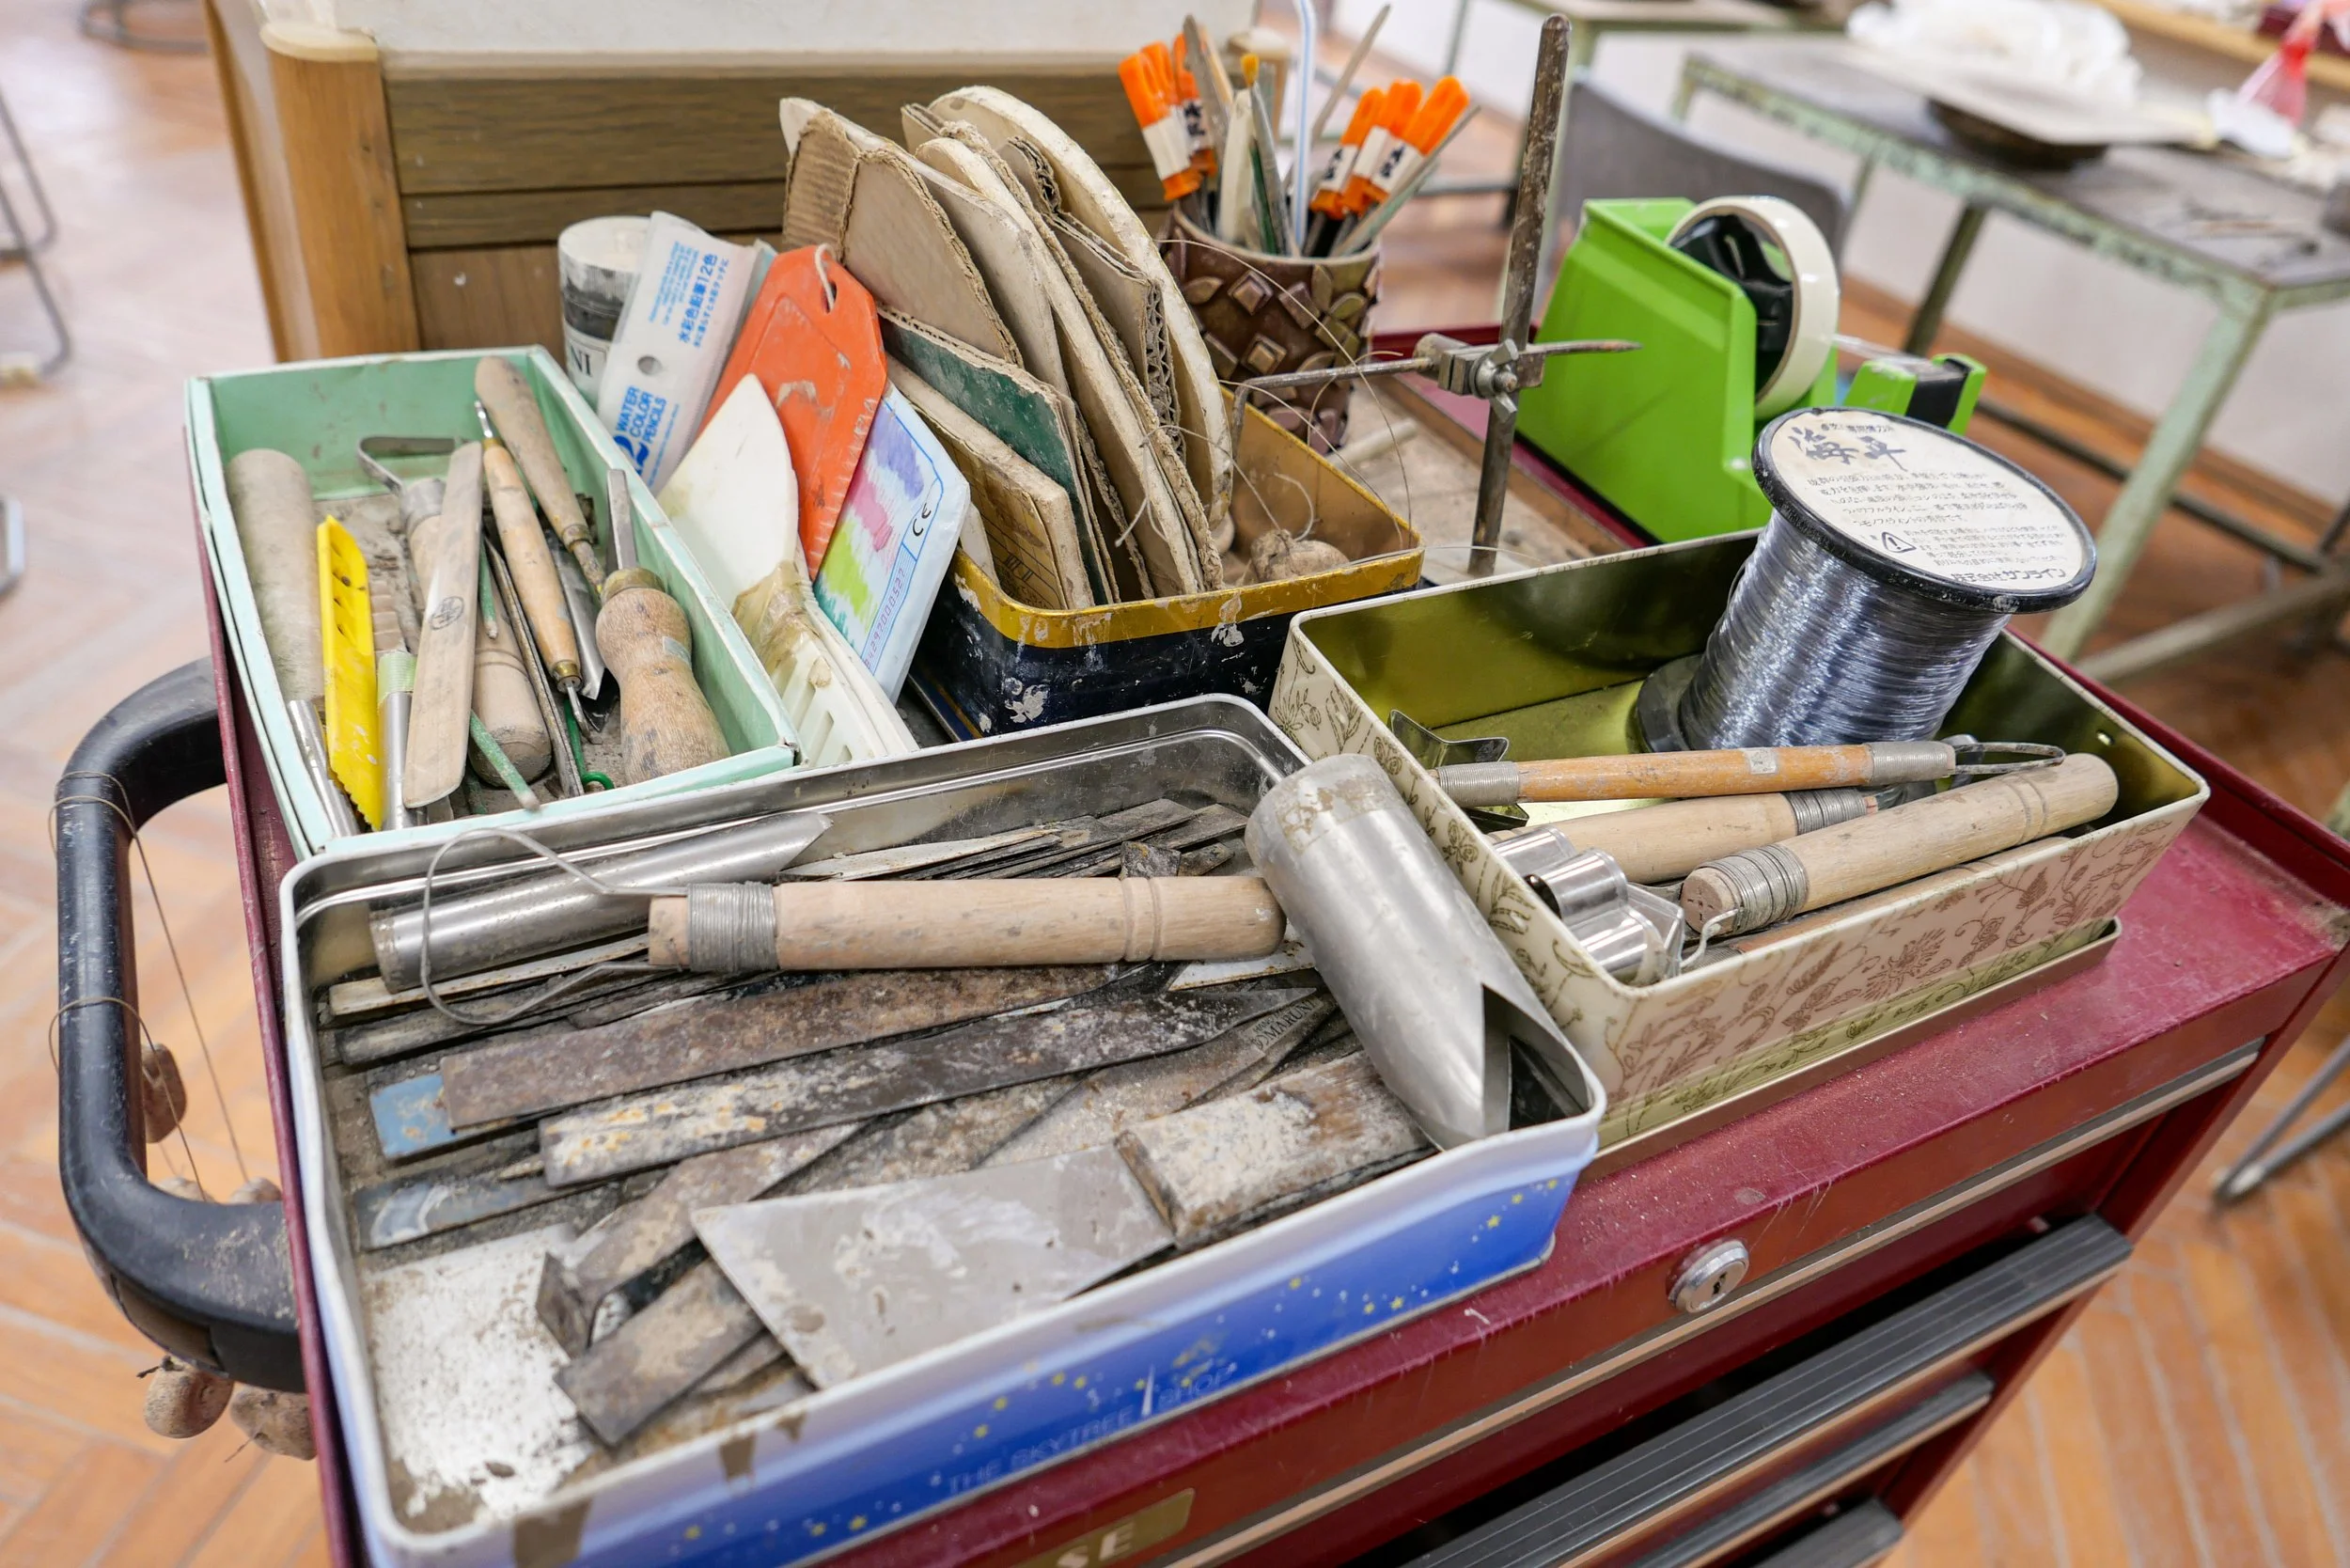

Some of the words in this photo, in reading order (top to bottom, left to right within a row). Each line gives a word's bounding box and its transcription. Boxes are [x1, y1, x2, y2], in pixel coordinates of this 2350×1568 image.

[616, 385, 640, 432] WATER
[630, 391, 654, 438] COLOR
[642, 398, 667, 444] PENCILS
[1950, 568, 2067, 583] 株式会社サンライン
[948, 1457, 1003, 1496] THE
[1010, 1405, 1136, 1472] SKYTREE
